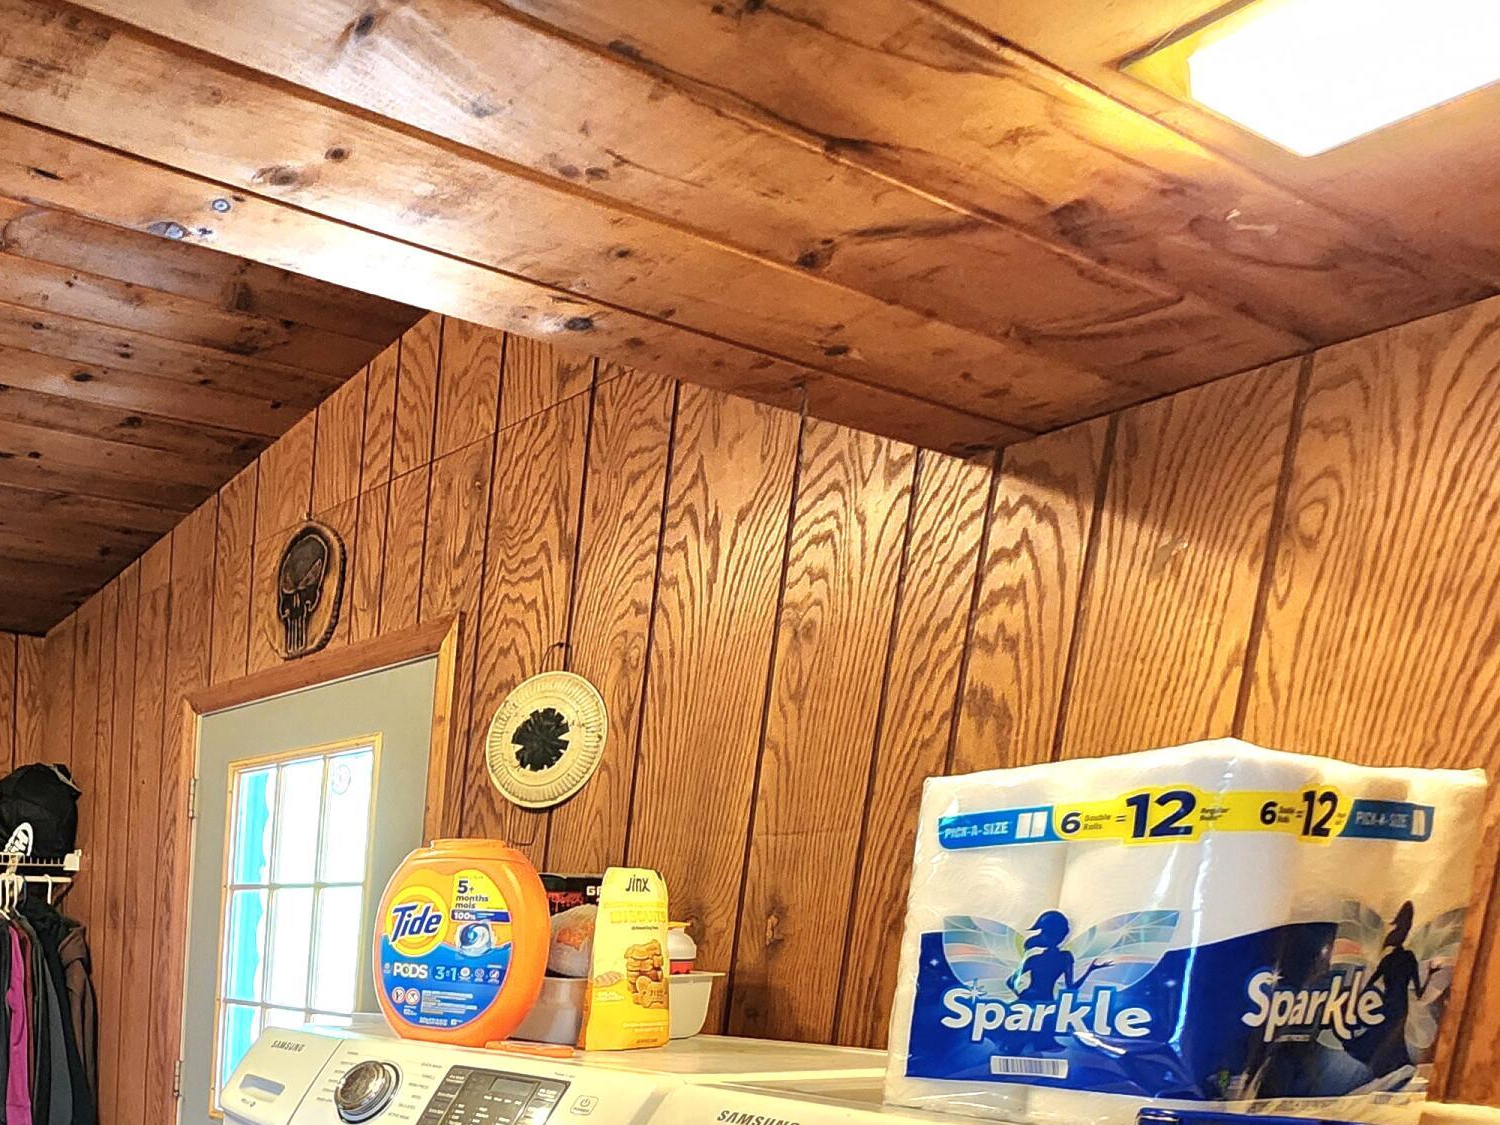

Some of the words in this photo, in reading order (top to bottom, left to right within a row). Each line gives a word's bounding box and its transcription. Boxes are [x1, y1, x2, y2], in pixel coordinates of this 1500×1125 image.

[1060, 810, 1082, 834] 6
[1126, 790, 1197, 839] 12
[1260, 801, 1279, 826] 6
[1302, 790, 1339, 838] 12
[1355, 810, 1411, 828] PICK-A-SIZE
[943, 820, 1010, 840] PICK-A-SIZE
[625, 873, 651, 893] jinx
[454, 900, 476, 910] mois
[455, 894, 489, 903] months
[391, 903, 443, 943] Tide
[393, 962, 429, 980] PODS
[941, 985, 1153, 1042] Sparkle
[1241, 970, 1387, 1043] Sparkle
[270, 1039, 306, 1053] SAMSUNG
